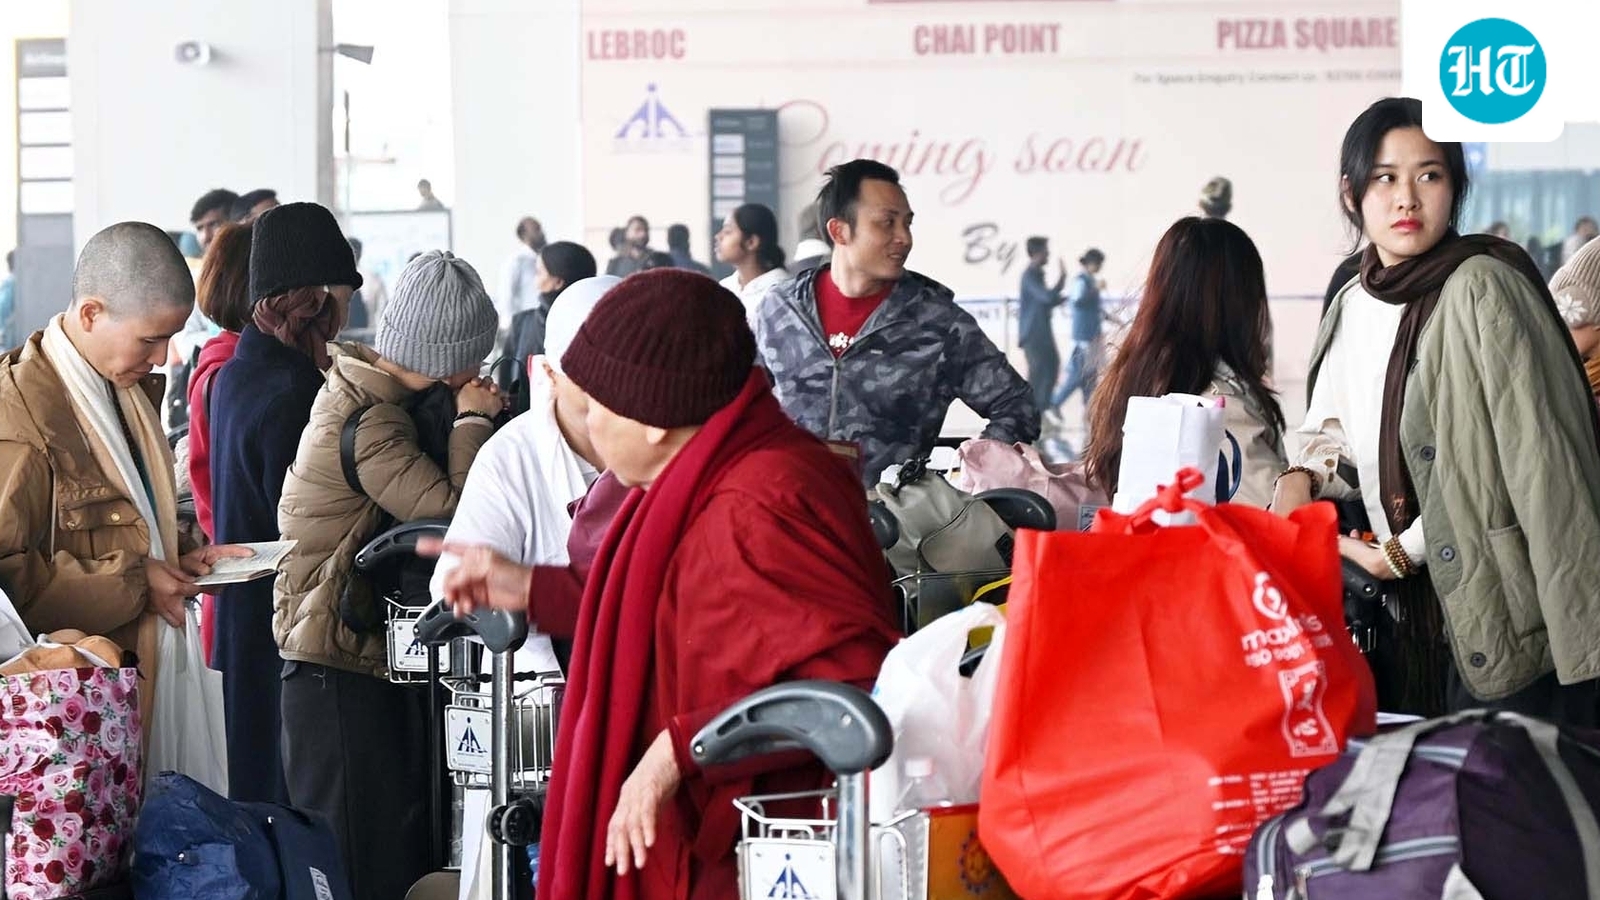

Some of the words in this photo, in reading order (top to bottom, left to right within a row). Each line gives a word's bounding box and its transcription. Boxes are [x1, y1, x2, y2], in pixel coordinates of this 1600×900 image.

[587, 29, 687, 60] LEBROC
[913, 23, 976, 56] CHAI
[984, 22, 1062, 54] POINT
[1216, 18, 1288, 50] PIZZA
[1293, 17, 1398, 49] SQUARE
[1013, 136, 1149, 175] soon
[961, 221, 1017, 276] By
